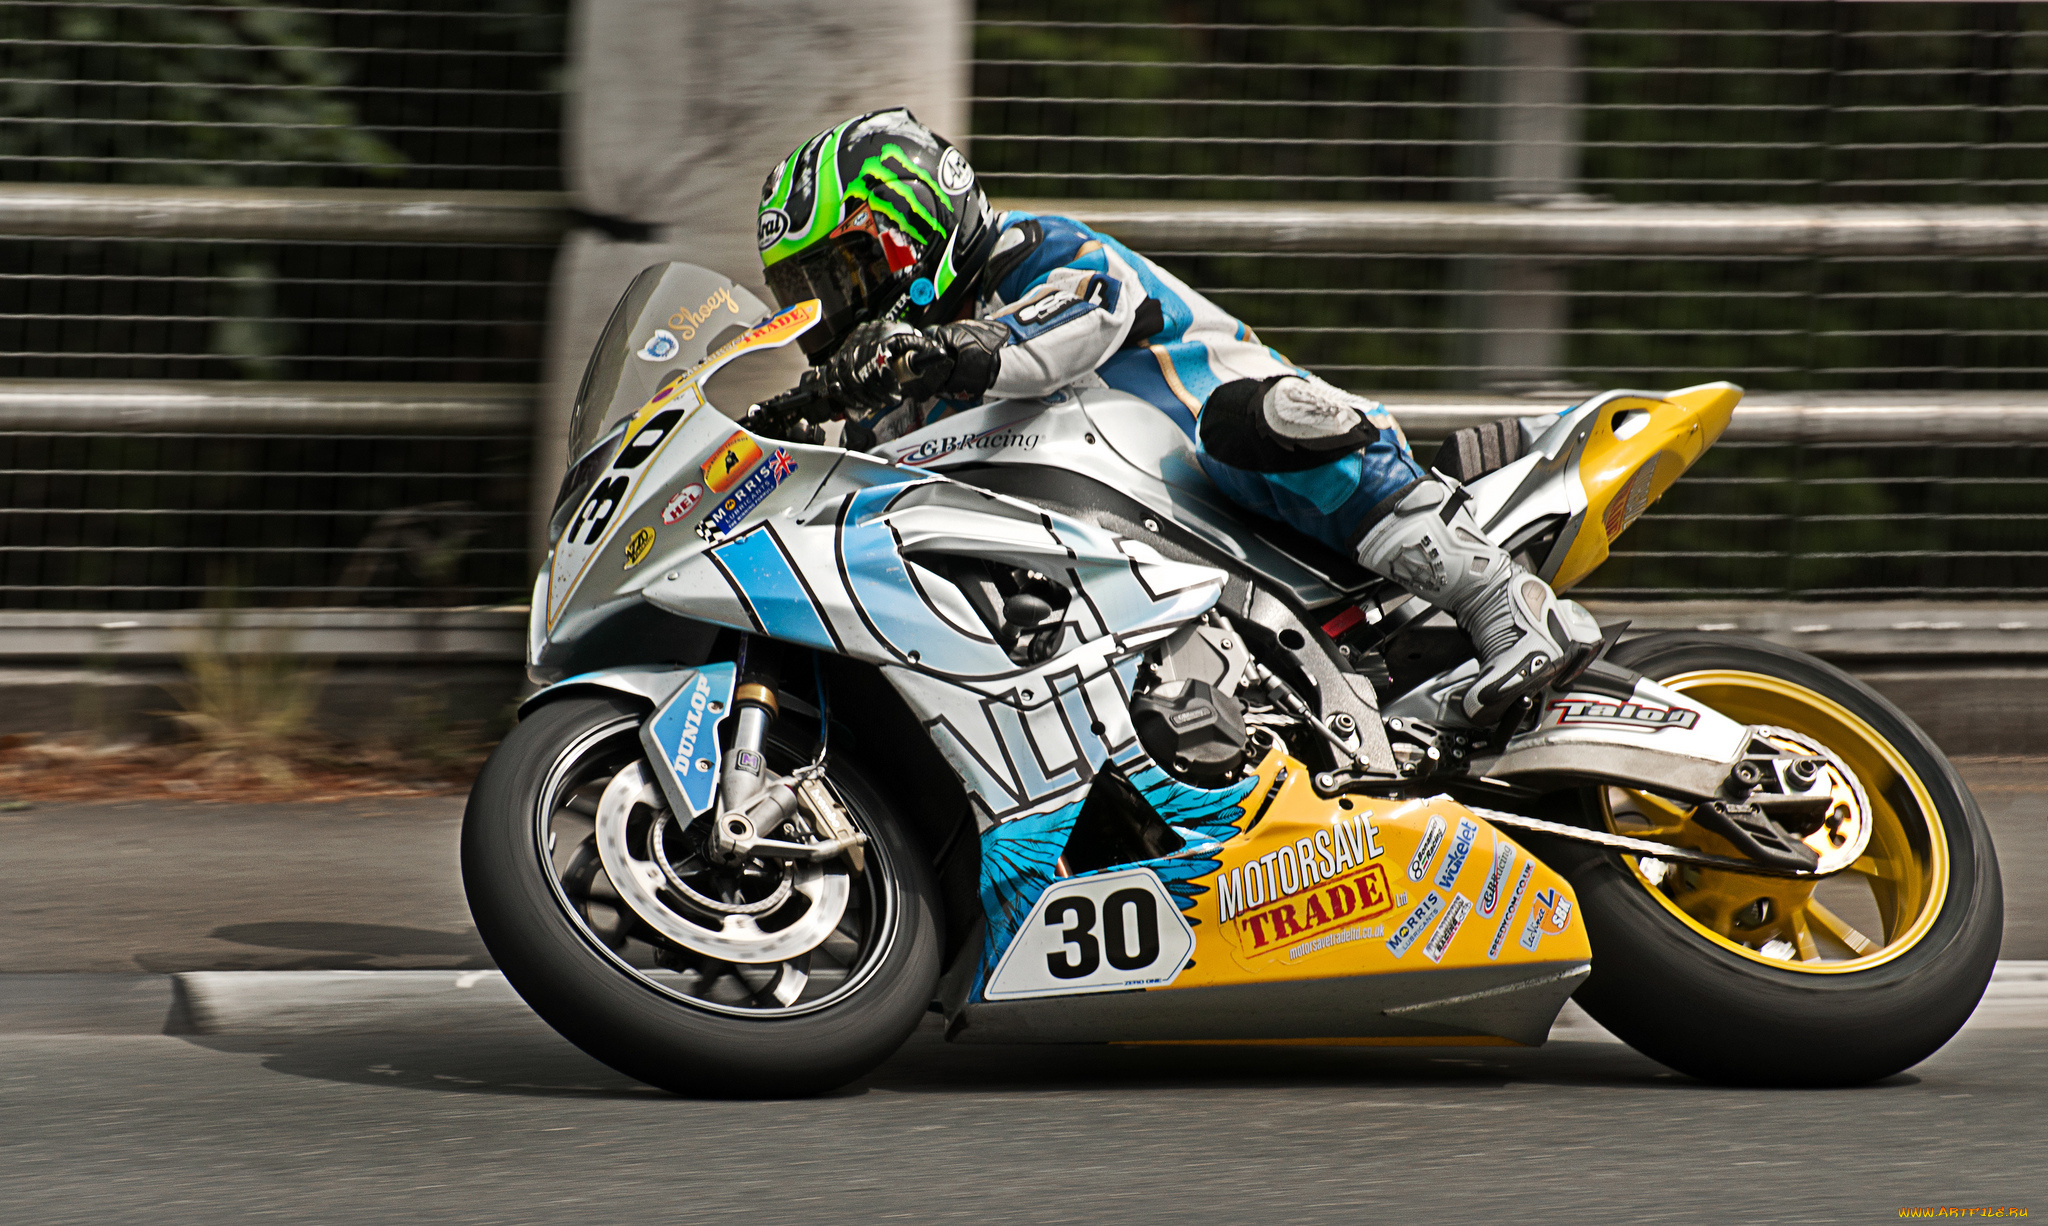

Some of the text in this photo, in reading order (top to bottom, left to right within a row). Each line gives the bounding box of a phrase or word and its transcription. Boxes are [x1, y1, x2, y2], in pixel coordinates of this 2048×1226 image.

[668, 286, 739, 341] Shoey
[567, 409, 685, 546] 30
[669, 493, 701, 520] HEL
[712, 464, 771, 524] MORRIS
[725, 480, 771, 525] LUBRICANTS
[674, 673, 711, 776] DUNLOP
[1217, 809, 1385, 924] MOTORSAVE
[1044, 887, 1161, 980] 30
[1241, 872, 1385, 949] TRADE
[1388, 893, 1438, 951] MORRIS
[1402, 908, 1440, 950] LUBRICANTS
[1489, 862, 1533, 957] SPEEDYCOM.CO.UK
[1551, 896, 1571, 930] SBK
[1289, 923, 1385, 961] motorsavetradeltd.co.uk
